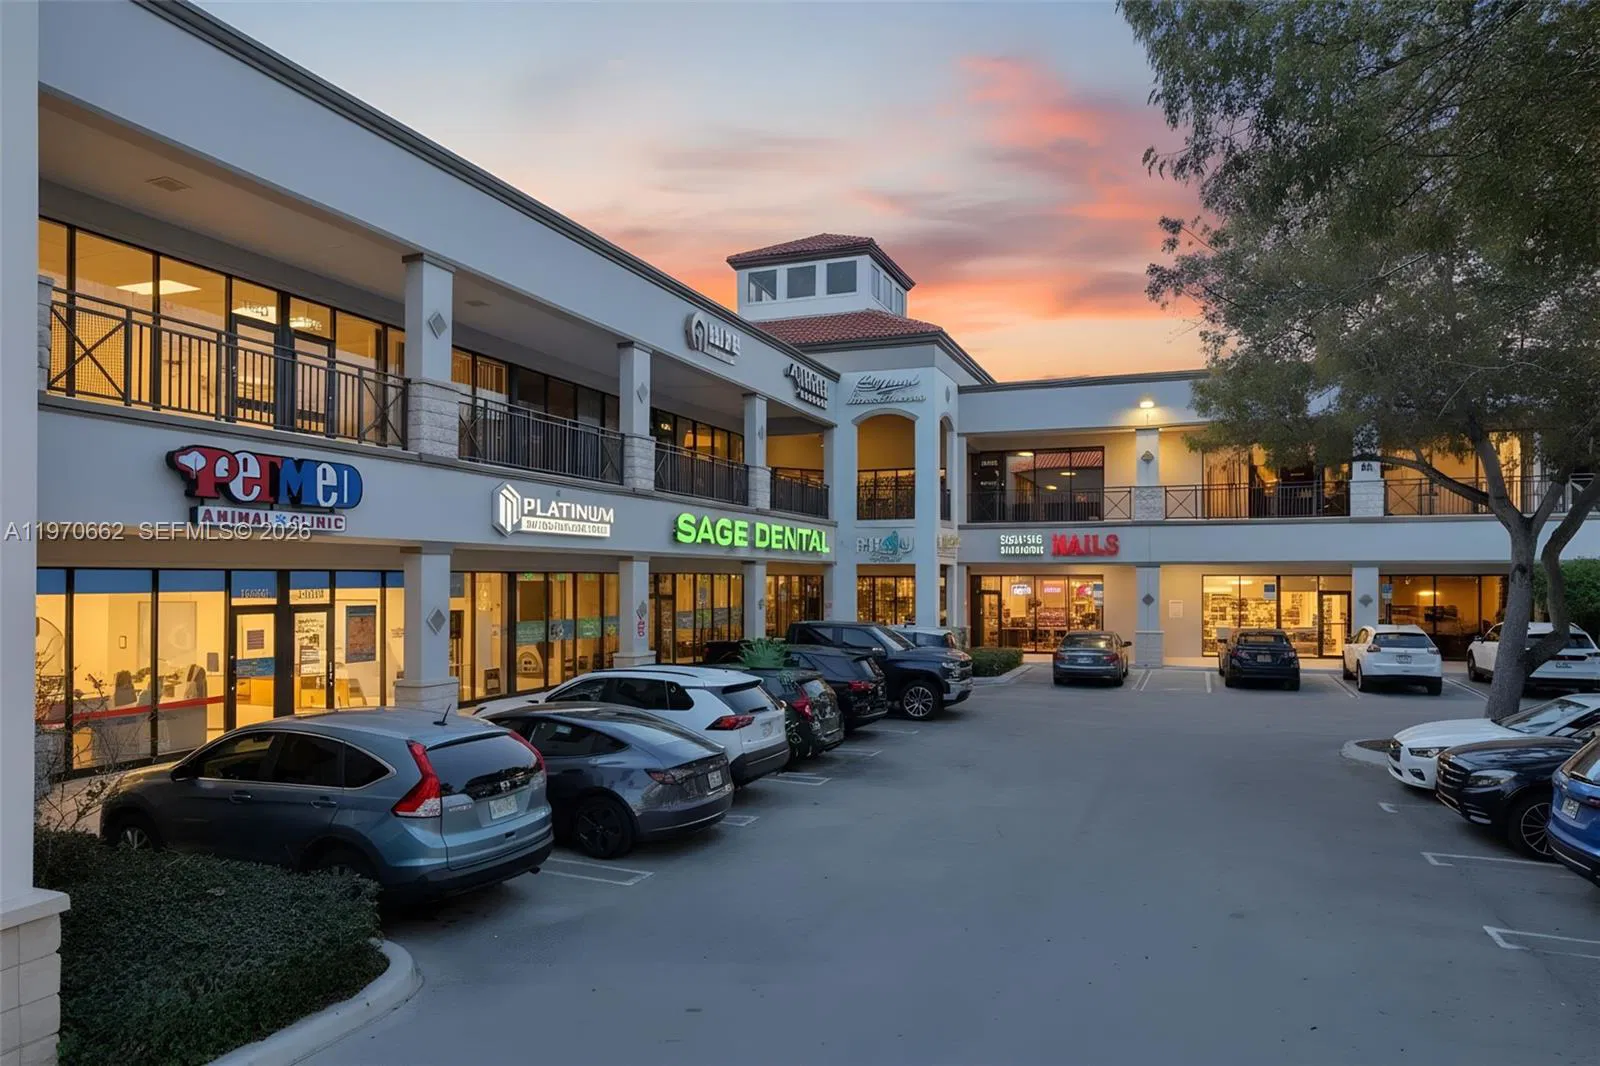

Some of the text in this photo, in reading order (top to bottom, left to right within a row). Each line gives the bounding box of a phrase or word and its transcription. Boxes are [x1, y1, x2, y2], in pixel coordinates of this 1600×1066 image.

[201, 508, 345, 530] ANIMAL CLINIC
[523, 497, 614, 523] PLATINUM
[675, 512, 749, 547] SAGE
[755, 522, 830, 554] DENTAL
[1051, 533, 1119, 556] NAILS
